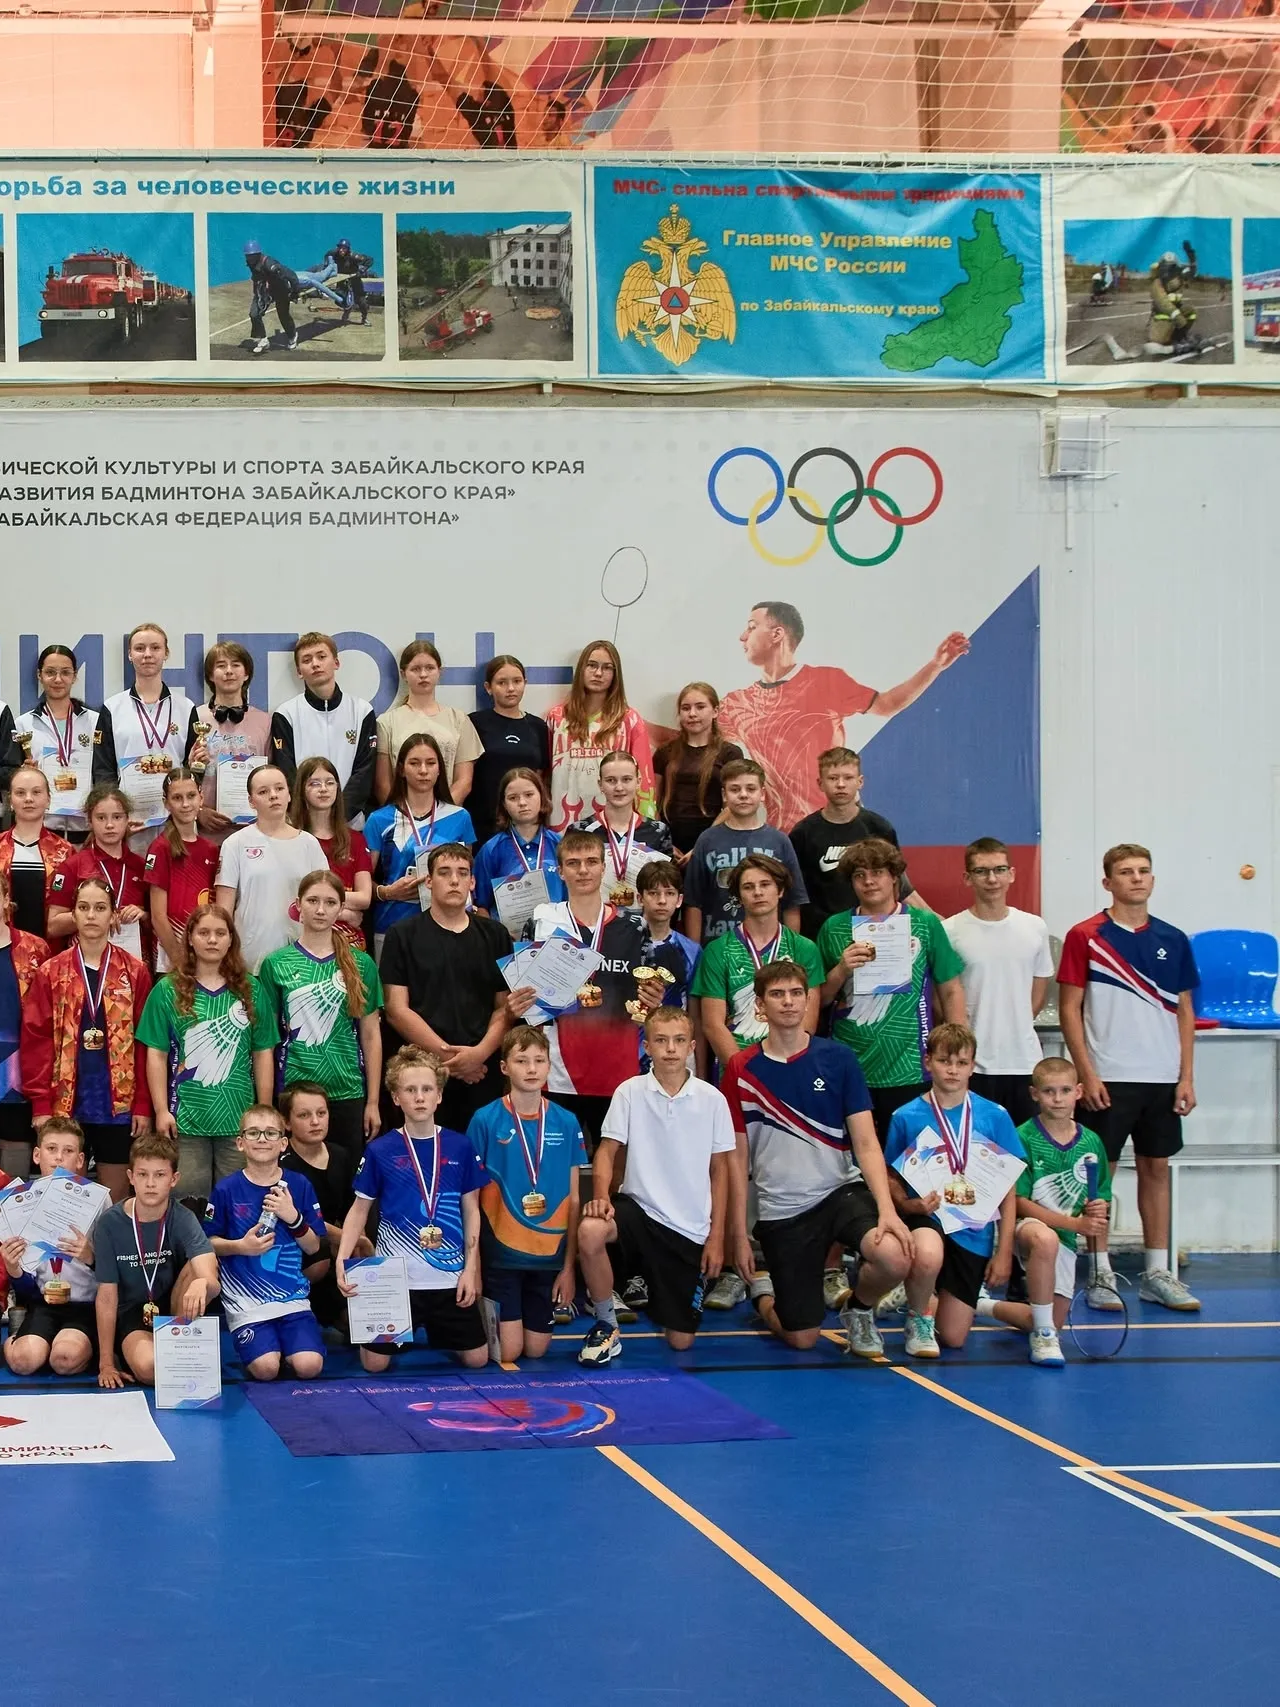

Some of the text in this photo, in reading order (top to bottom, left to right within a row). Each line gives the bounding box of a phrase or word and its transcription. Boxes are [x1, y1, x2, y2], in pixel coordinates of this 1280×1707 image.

[95, 180, 127, 196] за
[137, 179, 348, 196] человеческие
[360, 178, 455, 195] жизни
[673, 184, 748, 197] сильна
[723, 230, 952, 250] Главное Управление
[770, 255, 906, 274] МЧС России
[740, 299, 940, 316] по Забайкальскому краю
[105, 460, 216, 475] КУЛЬТУРЫ
[223, 460, 236, 475] И
[243, 460, 324, 475] СПОРТА
[331, 455, 525, 475] ЗАБАЙКАЛЬСКОГО
[532, 459, 584, 474] КРАЯ
[101, 486, 246, 503] БАДМИНТОНА
[252, 481, 447, 501] ЗАБАЙКАЛЬСКОГО
[454, 485, 516, 500] КРАЯ»
[174, 511, 302, 528] ФЕДЕРАЦИЯ
[309, 511, 460, 528] БАДМИНТОНА»
[706, 847, 747, 872] Call
[601, 959, 630, 974] NEX
